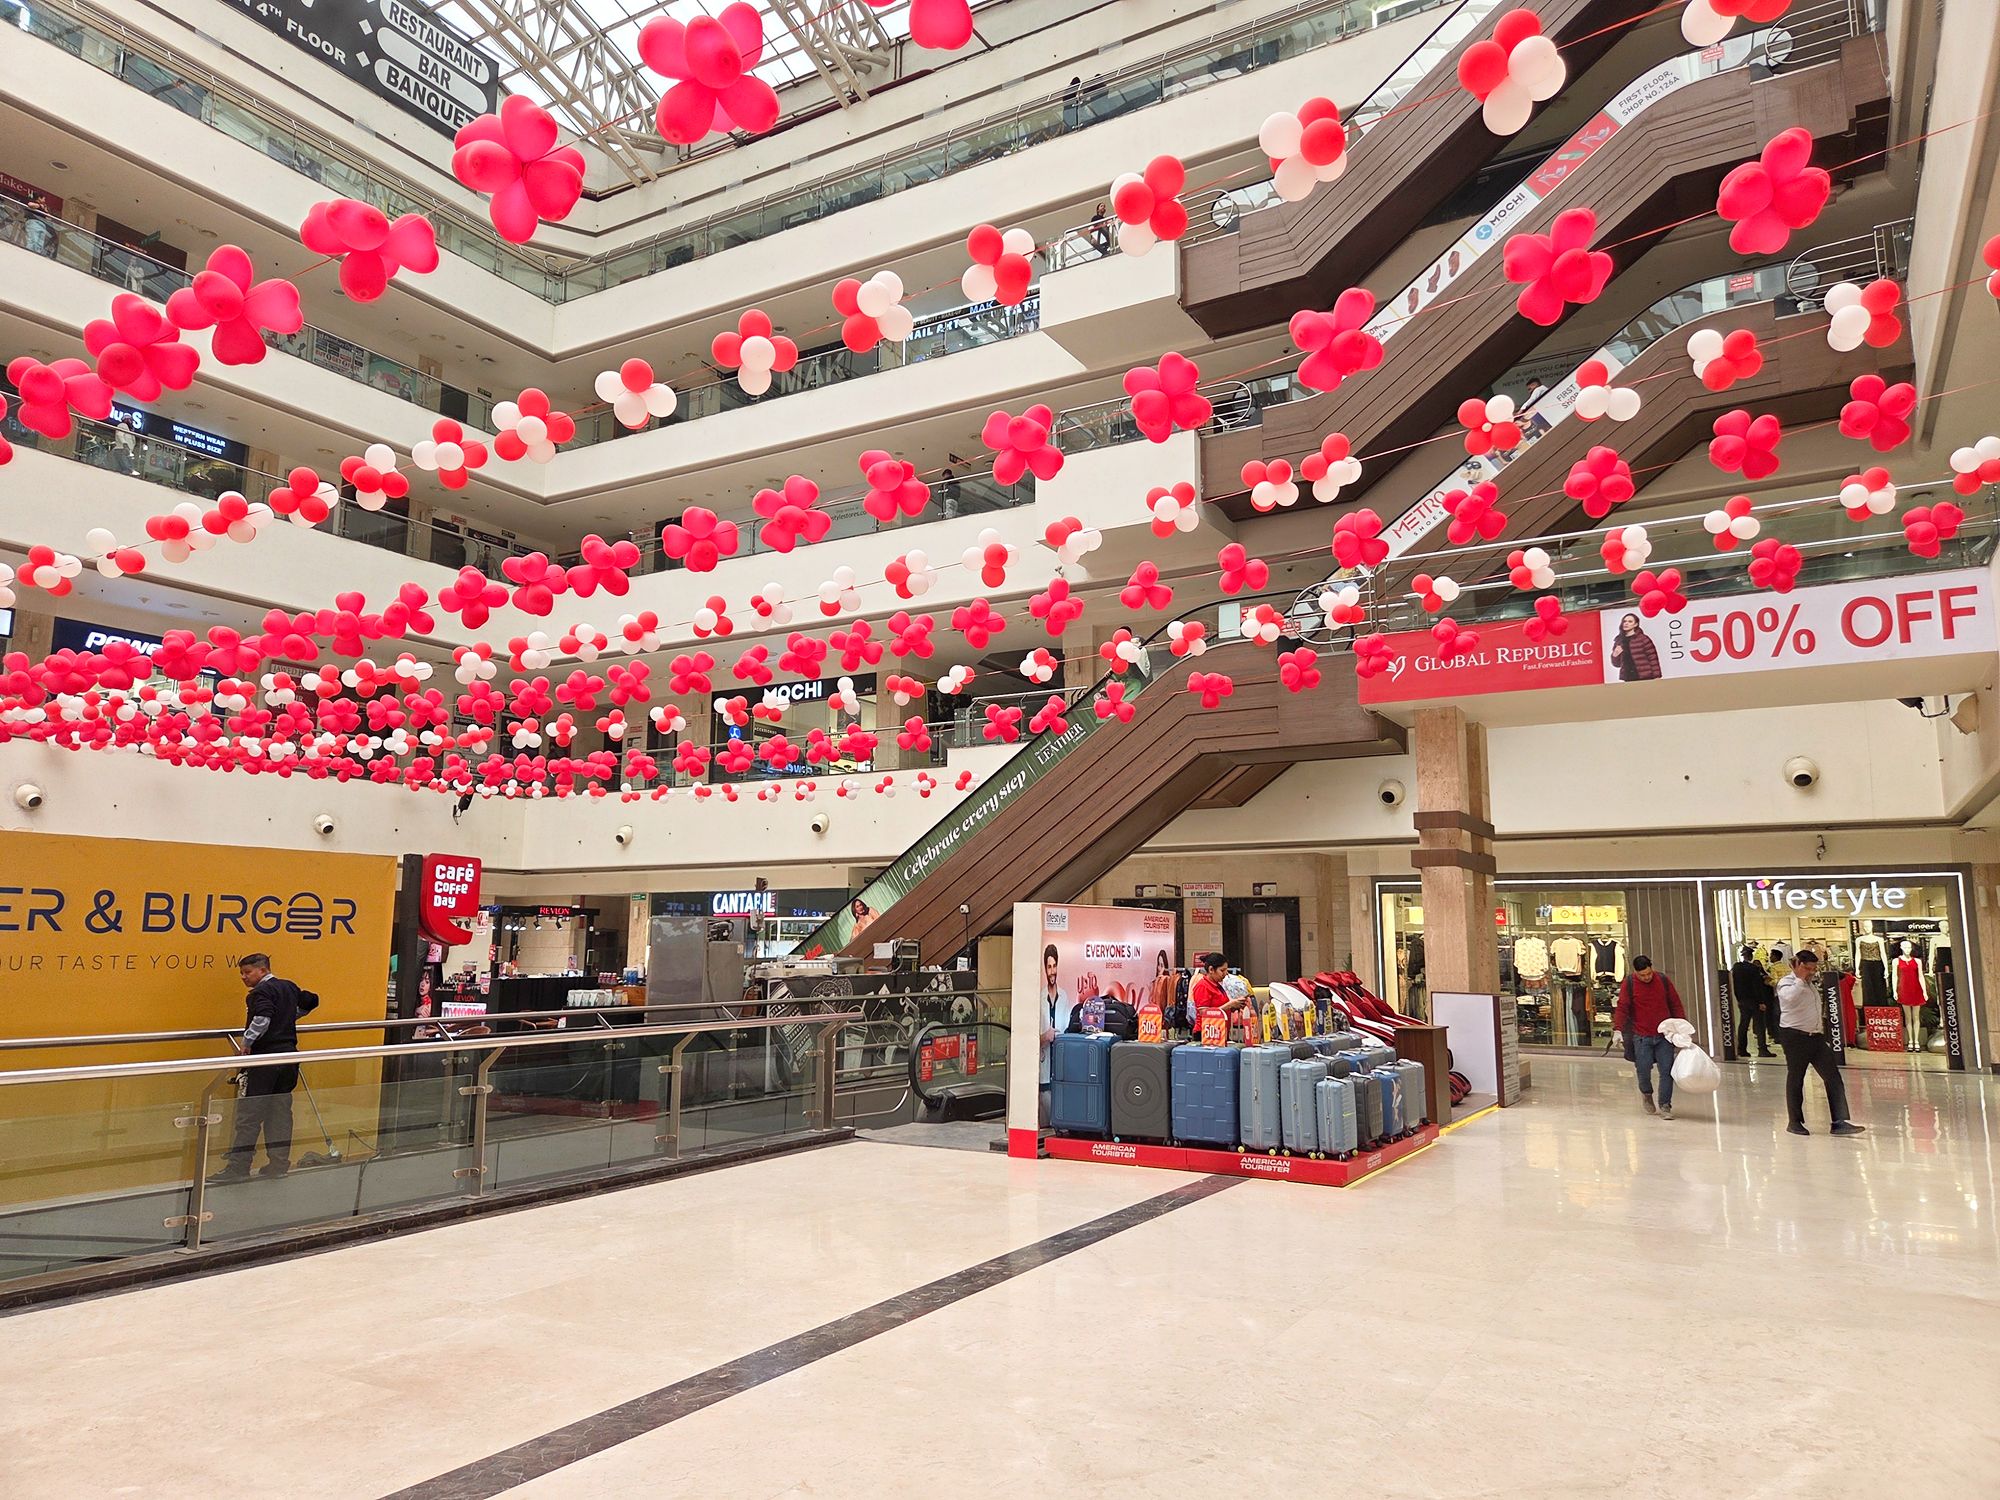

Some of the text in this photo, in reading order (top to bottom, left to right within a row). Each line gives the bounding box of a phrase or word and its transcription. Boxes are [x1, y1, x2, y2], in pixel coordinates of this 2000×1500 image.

[286, 17, 347, 65] FLOOR
[389, 2, 482, 78] RESTAURANT
[418, 53, 451, 91] BAR
[1618, 70, 1673, 108] FIRST FLOOR,
[1622, 100, 1644, 117] SHOP
[1489, 192, 1526, 226] MOCHI
[970, 301, 993, 314] MAK
[906, 327, 933, 342] NAIL
[1556, 383, 1577, 402] FIRST
[1562, 392, 1579, 409] SHOP
[175, 434, 183, 443] IN
[207, 444, 222, 455] SIZE
[206, 433, 226, 447] WEAR
[1392, 491, 1446, 539] METRO
[1414, 511, 1443, 536] SHOES
[1669, 586, 1978, 663] UPTO 50% OFF
[1415, 641, 1592, 672] GLOBAL REPUBLIC
[1037, 723, 1084, 765] LEATHER
[904, 827, 960, 880] Celebrate
[999, 770, 1026, 800] step
[1746, 879, 1906, 915] lifestyle
[85, 889, 122, 934] &
[539, 906, 570, 915] REVLON
[1144, 915, 1170, 923] AMERICAN
[1143, 922, 1170, 930] TOURISTER
[0, 955, 43, 971] UR
[57, 954, 138, 970] TASTE
[150, 954, 214, 969] YOUR
[1085, 943, 1141, 958] EVERYONE'S IN
[1720, 983, 1730, 1020] GABBANA
[1828, 986, 1839, 1024] GABBANA
[1945, 987, 1957, 1027] GABBANA
[1868, 1018, 1899, 1026] DRESS
[1722, 1023, 1732, 1047] DOLCE
[1831, 1028, 1842, 1052] DOLCE
[1949, 1031, 1960, 1056] DOLCE
[1091, 1149, 1136, 1159] TOURISTER
[1092, 1143, 1136, 1153] AMERICAN
[1240, 1162, 1290, 1174] TOURISTER
[1241, 1156, 1290, 1167] AMERICAN
